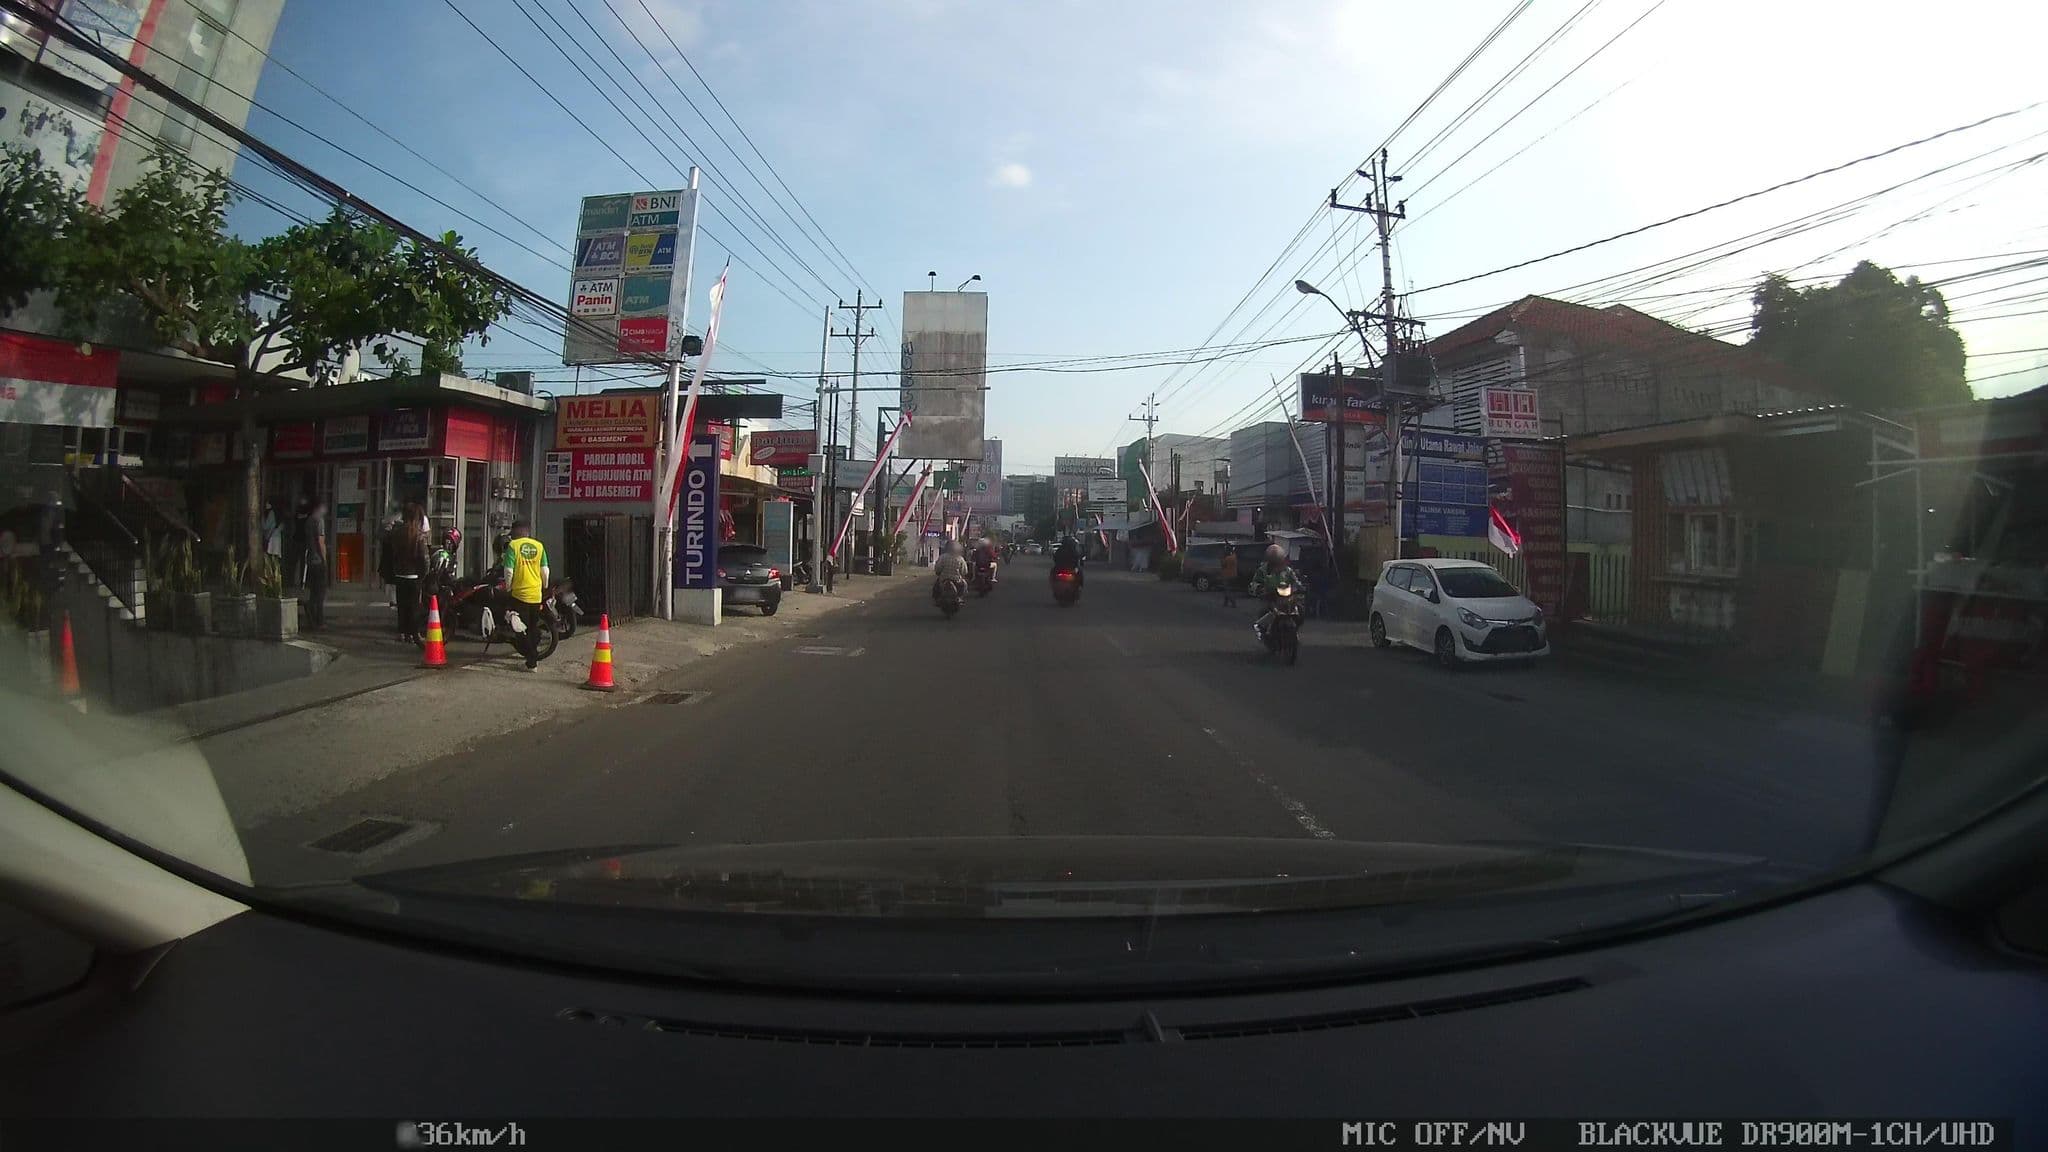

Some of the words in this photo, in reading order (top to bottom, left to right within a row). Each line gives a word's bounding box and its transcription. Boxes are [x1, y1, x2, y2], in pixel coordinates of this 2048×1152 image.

[650, 196, 677, 209] BNI
[632, 214, 660, 226] ATM
[596, 241, 616, 251] ATM
[657, 246, 672, 254] ATM
[590, 282, 613, 293] ATM
[577, 294, 612, 306] Panin
[625, 295, 650, 305] ATM
[567, 399, 647, 419] MELIA
[1488, 419, 1538, 430] BUNGAH
[1420, 436, 1443, 452] Utama
[1443, 439, 1465, 453] Rawat
[584, 453, 616, 466] PARKIR
[617, 452, 646, 465] MOBIL
[576, 469, 631, 482] PENGUNJUNG
[632, 468, 652, 481] ATM
[585, 485, 595, 498] DI
[595, 485, 642, 498] BASEMENT
[686, 469, 706, 584] TURINDO
